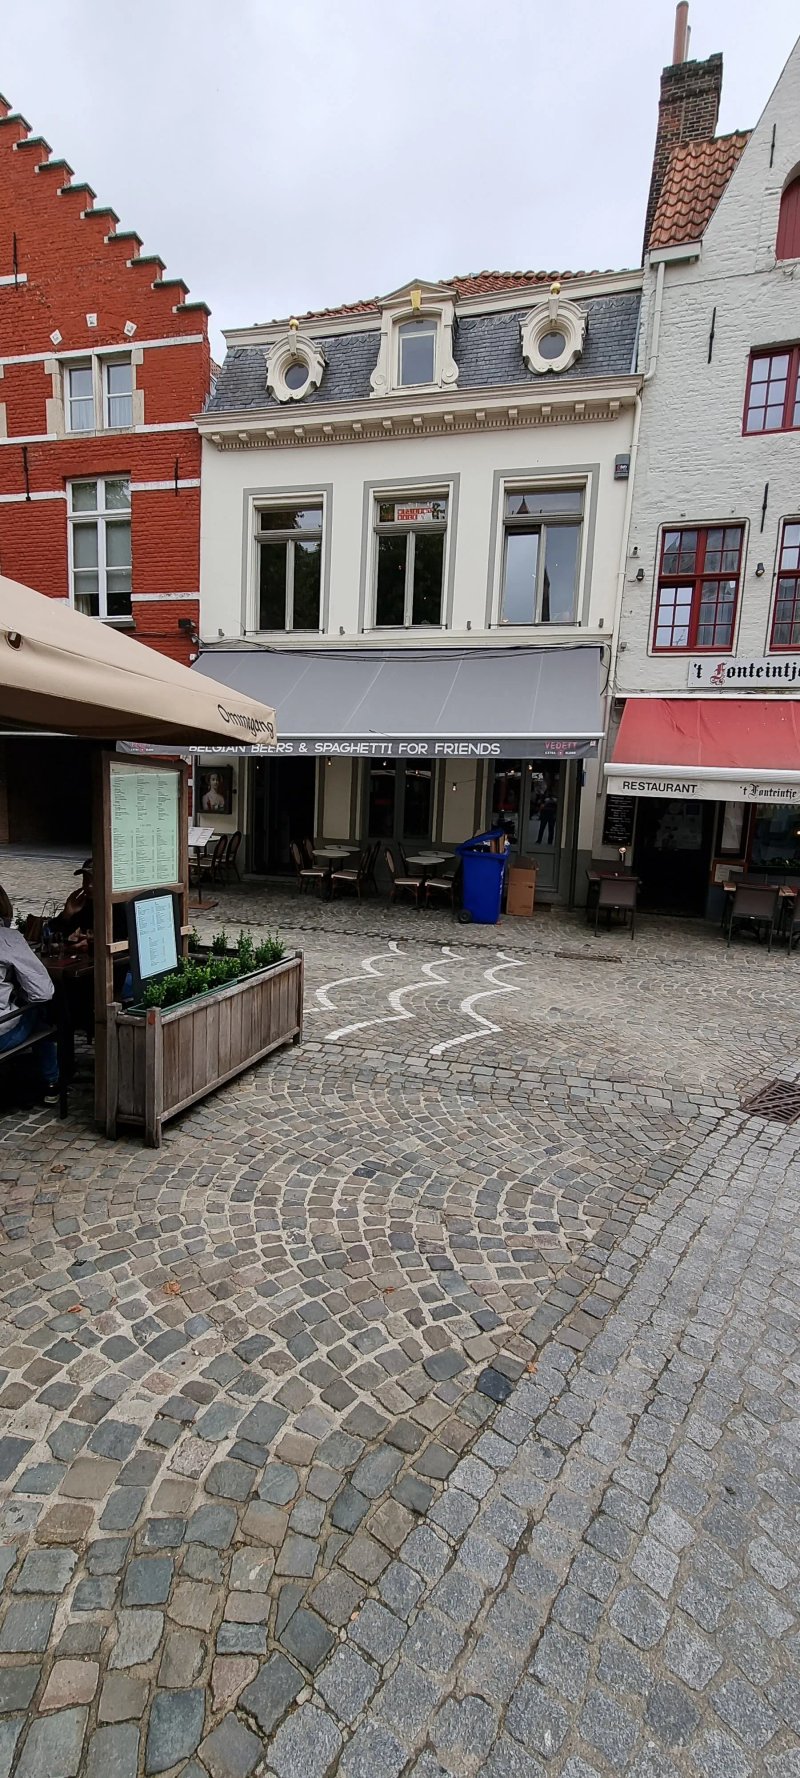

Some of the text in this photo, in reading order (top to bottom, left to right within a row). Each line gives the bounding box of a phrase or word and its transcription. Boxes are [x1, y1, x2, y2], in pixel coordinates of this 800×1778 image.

[694, 662, 800, 686] 't Fonteintj
[251, 742, 294, 753] BEERS
[298, 742, 308, 753] &
[314, 742, 393, 754] SPAGHETTI
[398, 743, 428, 755] FOR
[434, 743, 501, 755] FRIENDS
[544, 741, 577, 750] VEDETT
[622, 781, 698, 794] RESTAURANT
[748, 783, 797, 799] Fonteintje
